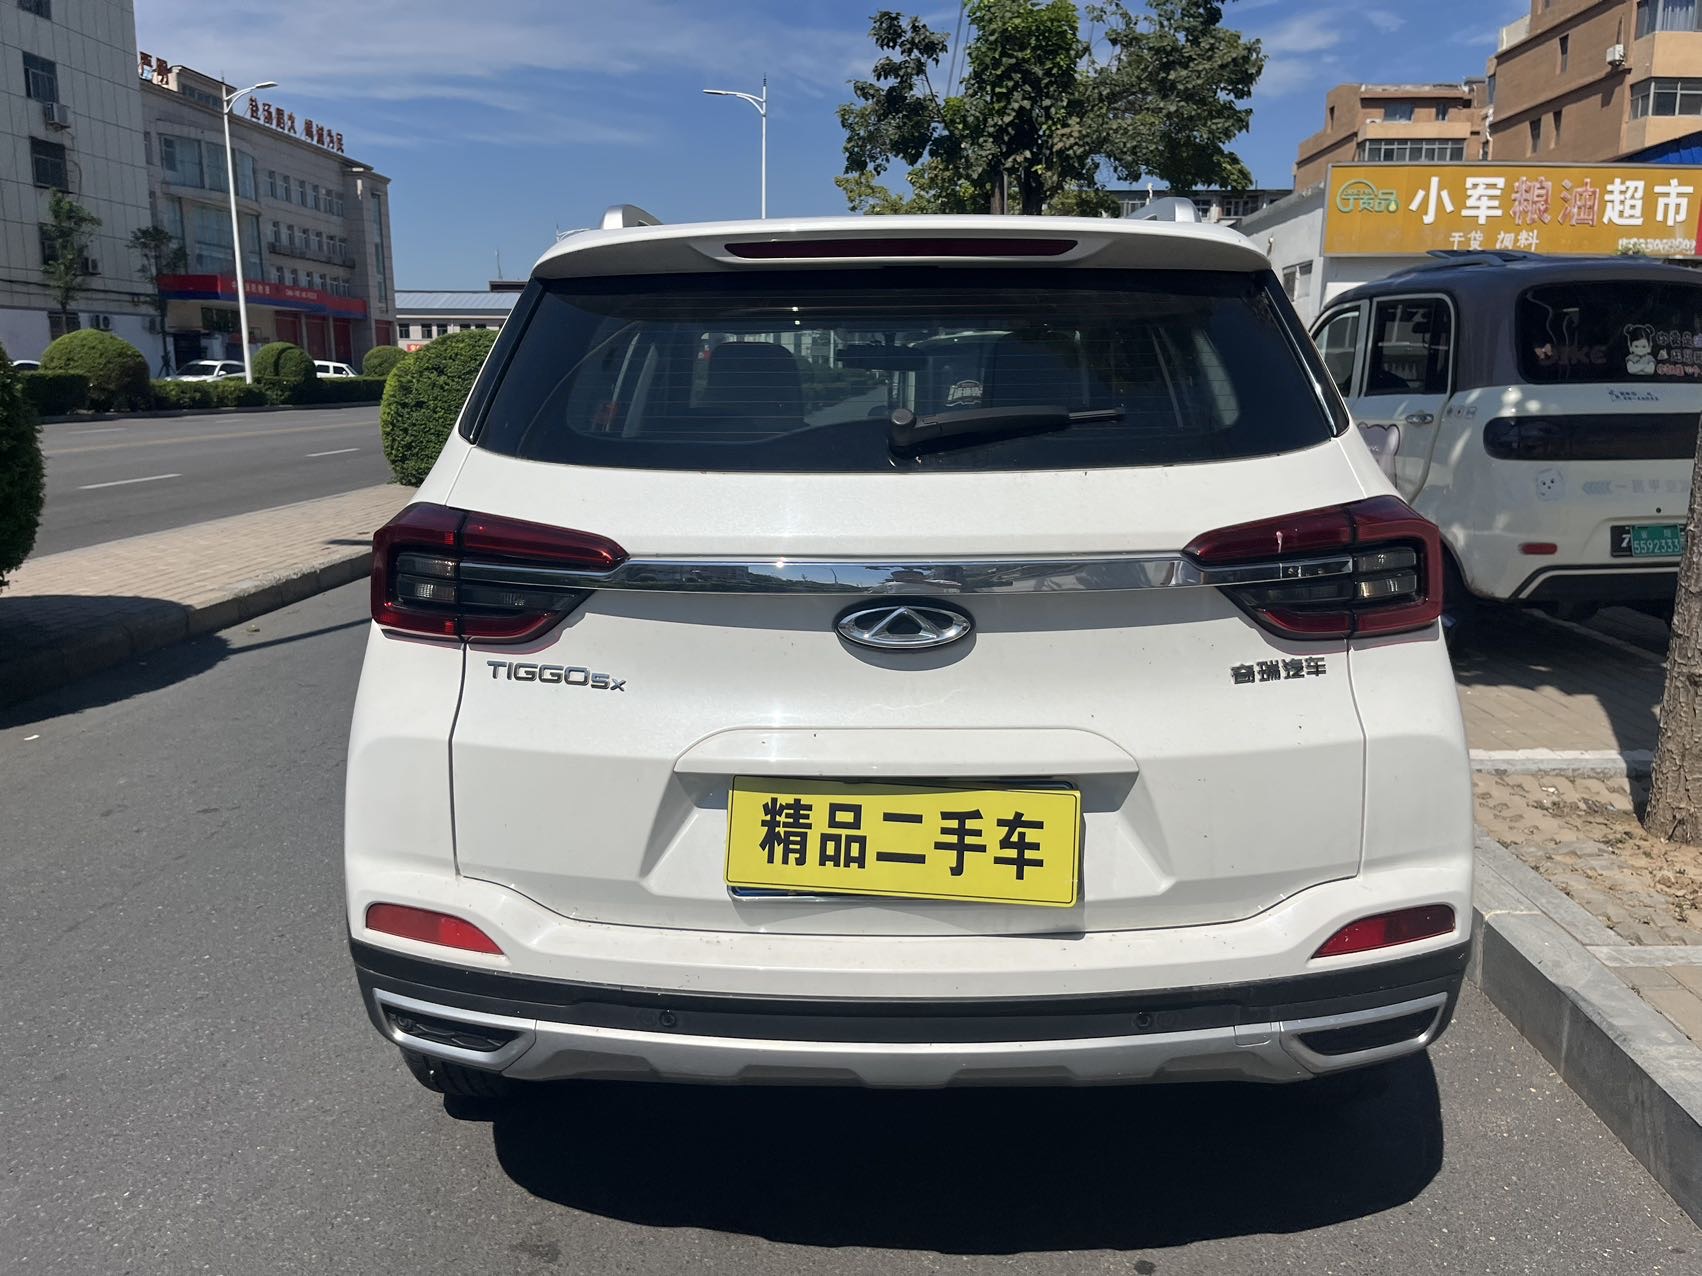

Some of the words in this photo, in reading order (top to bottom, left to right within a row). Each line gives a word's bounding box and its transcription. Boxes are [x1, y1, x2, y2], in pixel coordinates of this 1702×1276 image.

[1408, 175, 1694, 227] 小军粮油超市
[1633, 538, 1680, 553] 5592333
[1230, 656, 1327, 685] 奇瑞汽车
[759, 796, 1045, 881] 精品二手车
